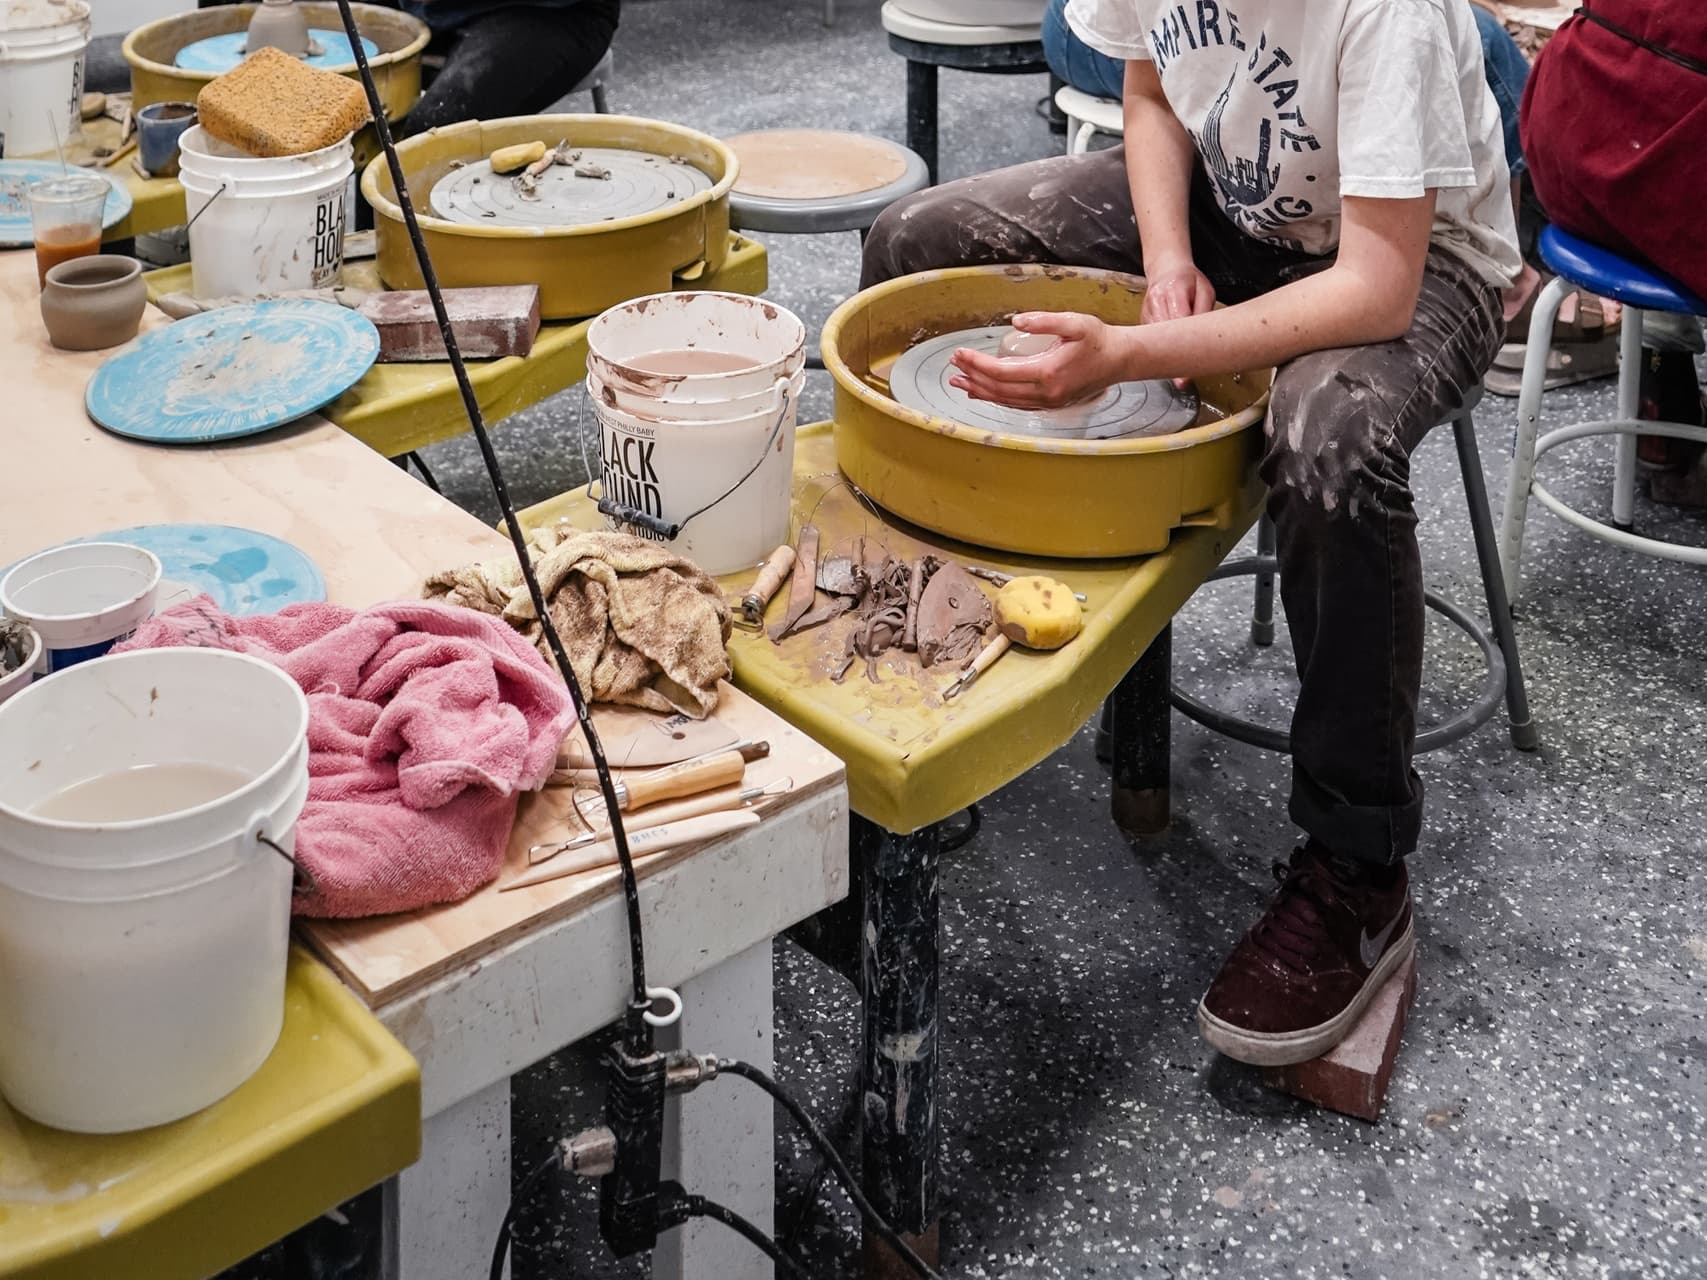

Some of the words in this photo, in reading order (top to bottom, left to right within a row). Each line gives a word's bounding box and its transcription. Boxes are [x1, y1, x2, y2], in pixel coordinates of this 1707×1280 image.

[1151, 0, 1246, 77] MPIRE
[315, 195, 345, 236] BLA
[314, 226, 344, 269] HOU
[596, 416, 660, 484] LACK
[617, 421, 635, 433] PHILLY
[636, 425, 655, 437] BABY
[600, 465, 662, 520] OUND
